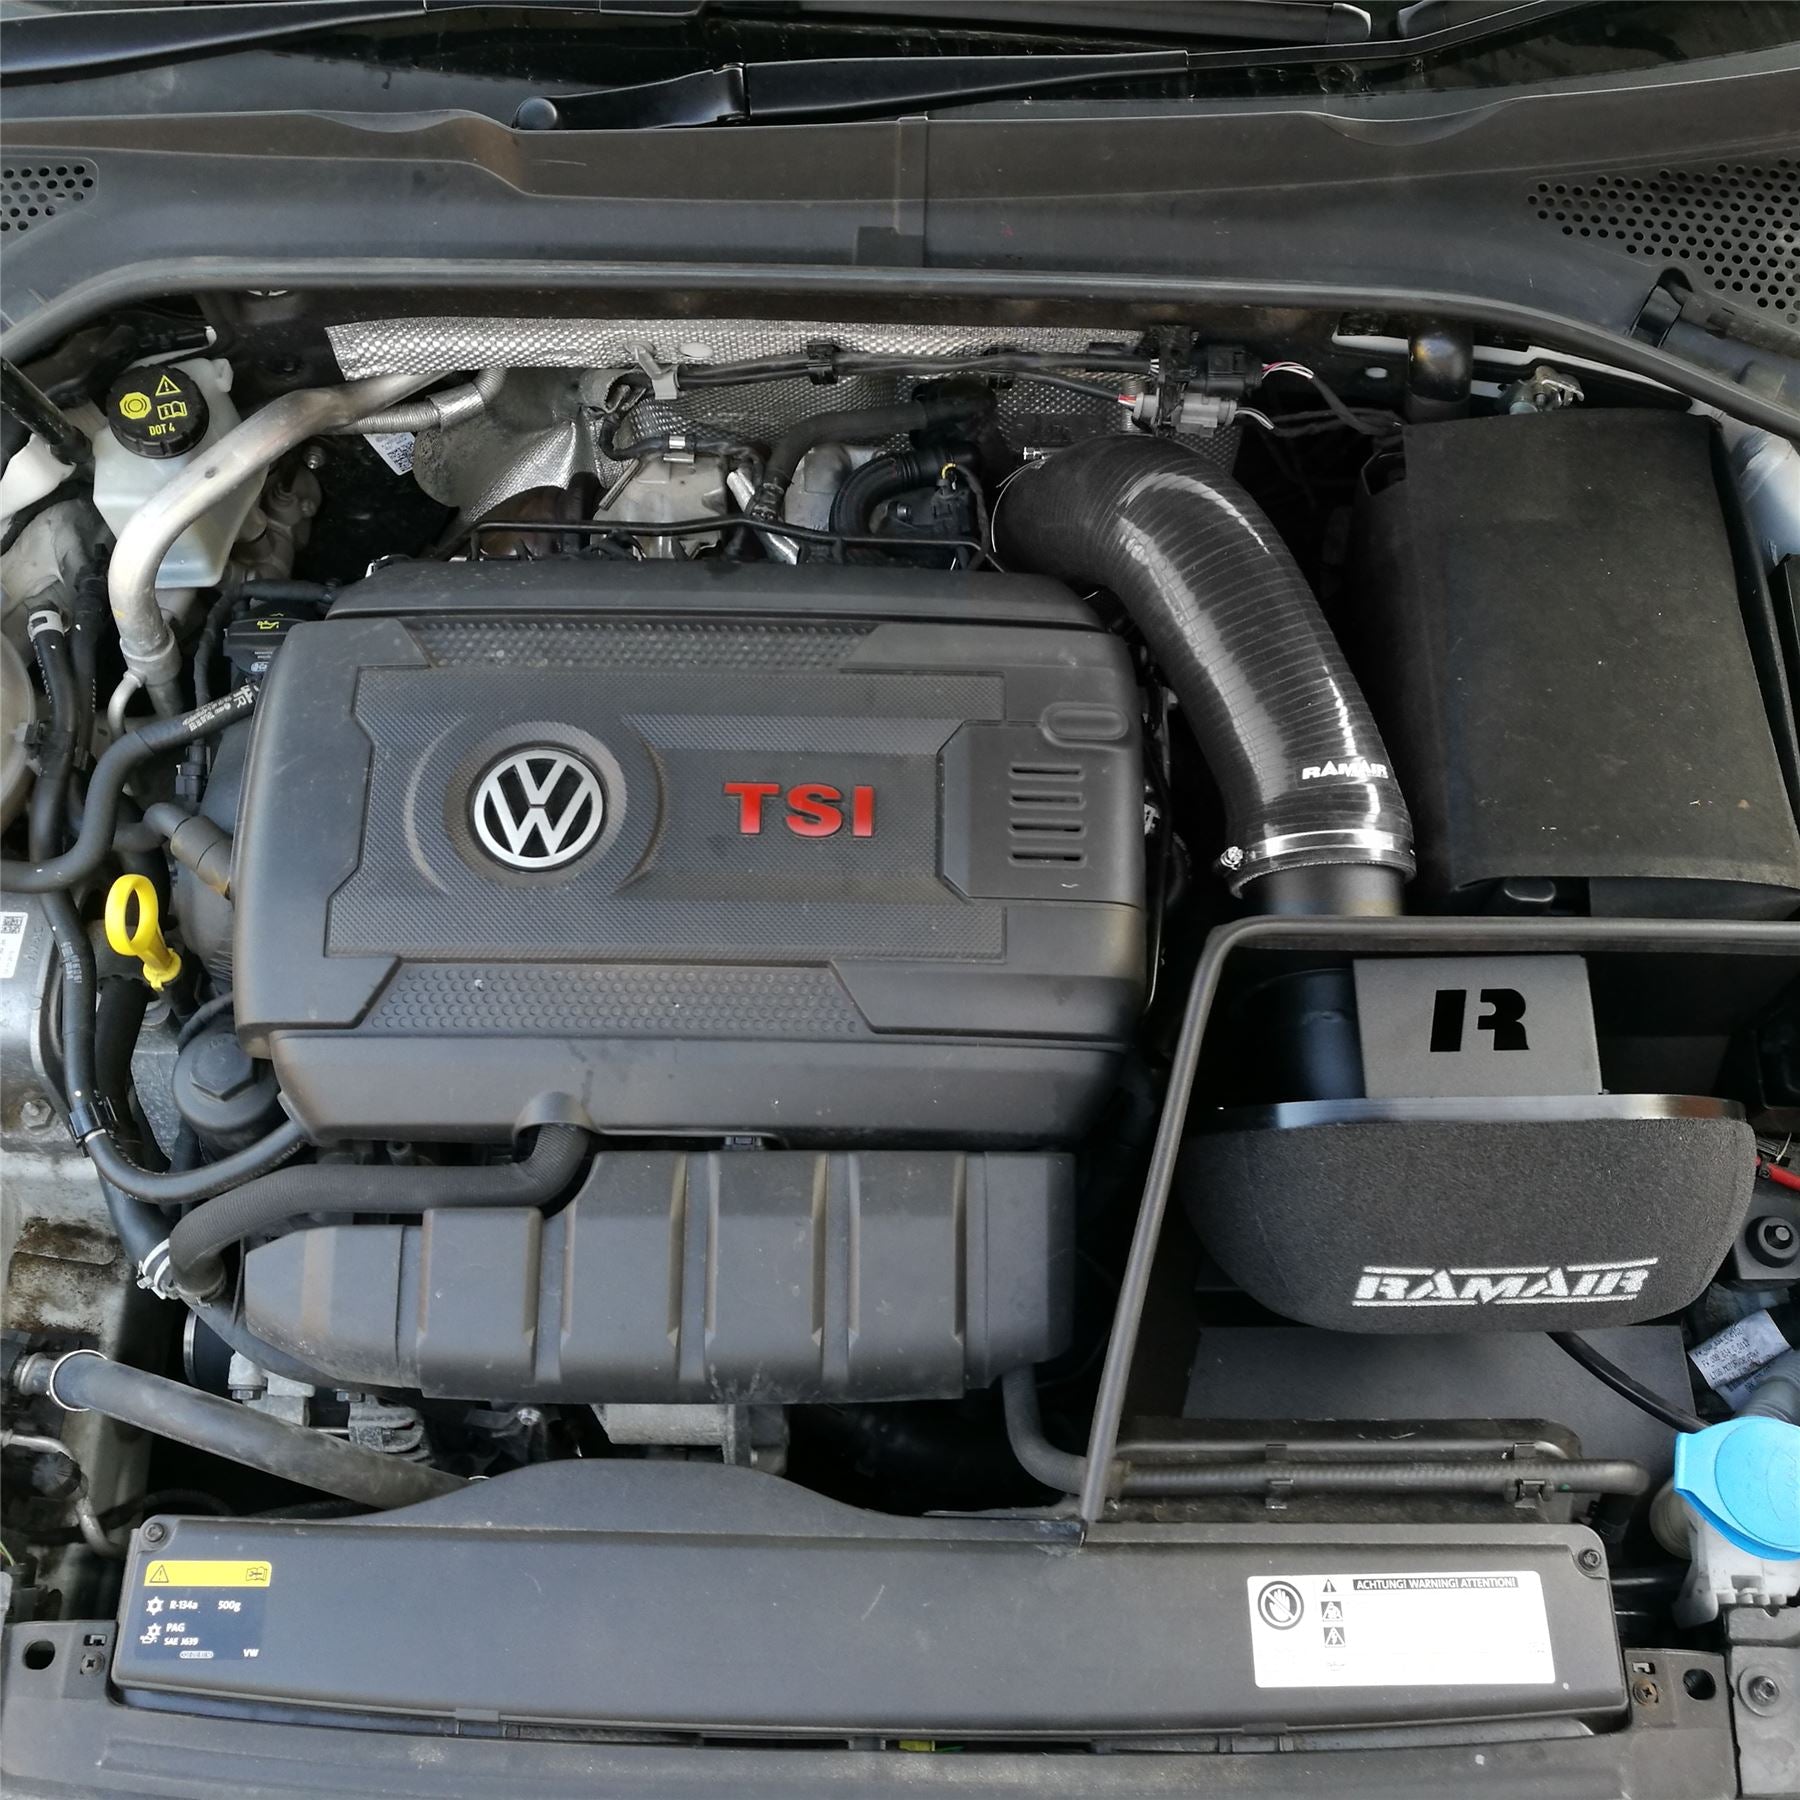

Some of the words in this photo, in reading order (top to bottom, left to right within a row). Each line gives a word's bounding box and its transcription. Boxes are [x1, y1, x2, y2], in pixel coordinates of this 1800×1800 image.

[149, 423, 166, 436] DOT
[168, 422, 175, 432] 4
[474, 749, 603, 868] VW
[723, 782, 874, 837] TSI
[1353, 1264, 1651, 1306] RAMAIR
[1356, 1578, 1407, 1590] ACHTUNG!
[1408, 1578, 1459, 1590] WARNING!
[1461, 1577, 1517, 1589] ATTENTION!
[218, 1600, 241, 1612] 500g
[166, 1622, 186, 1632] PAG
[243, 1648, 259, 1657] VW
